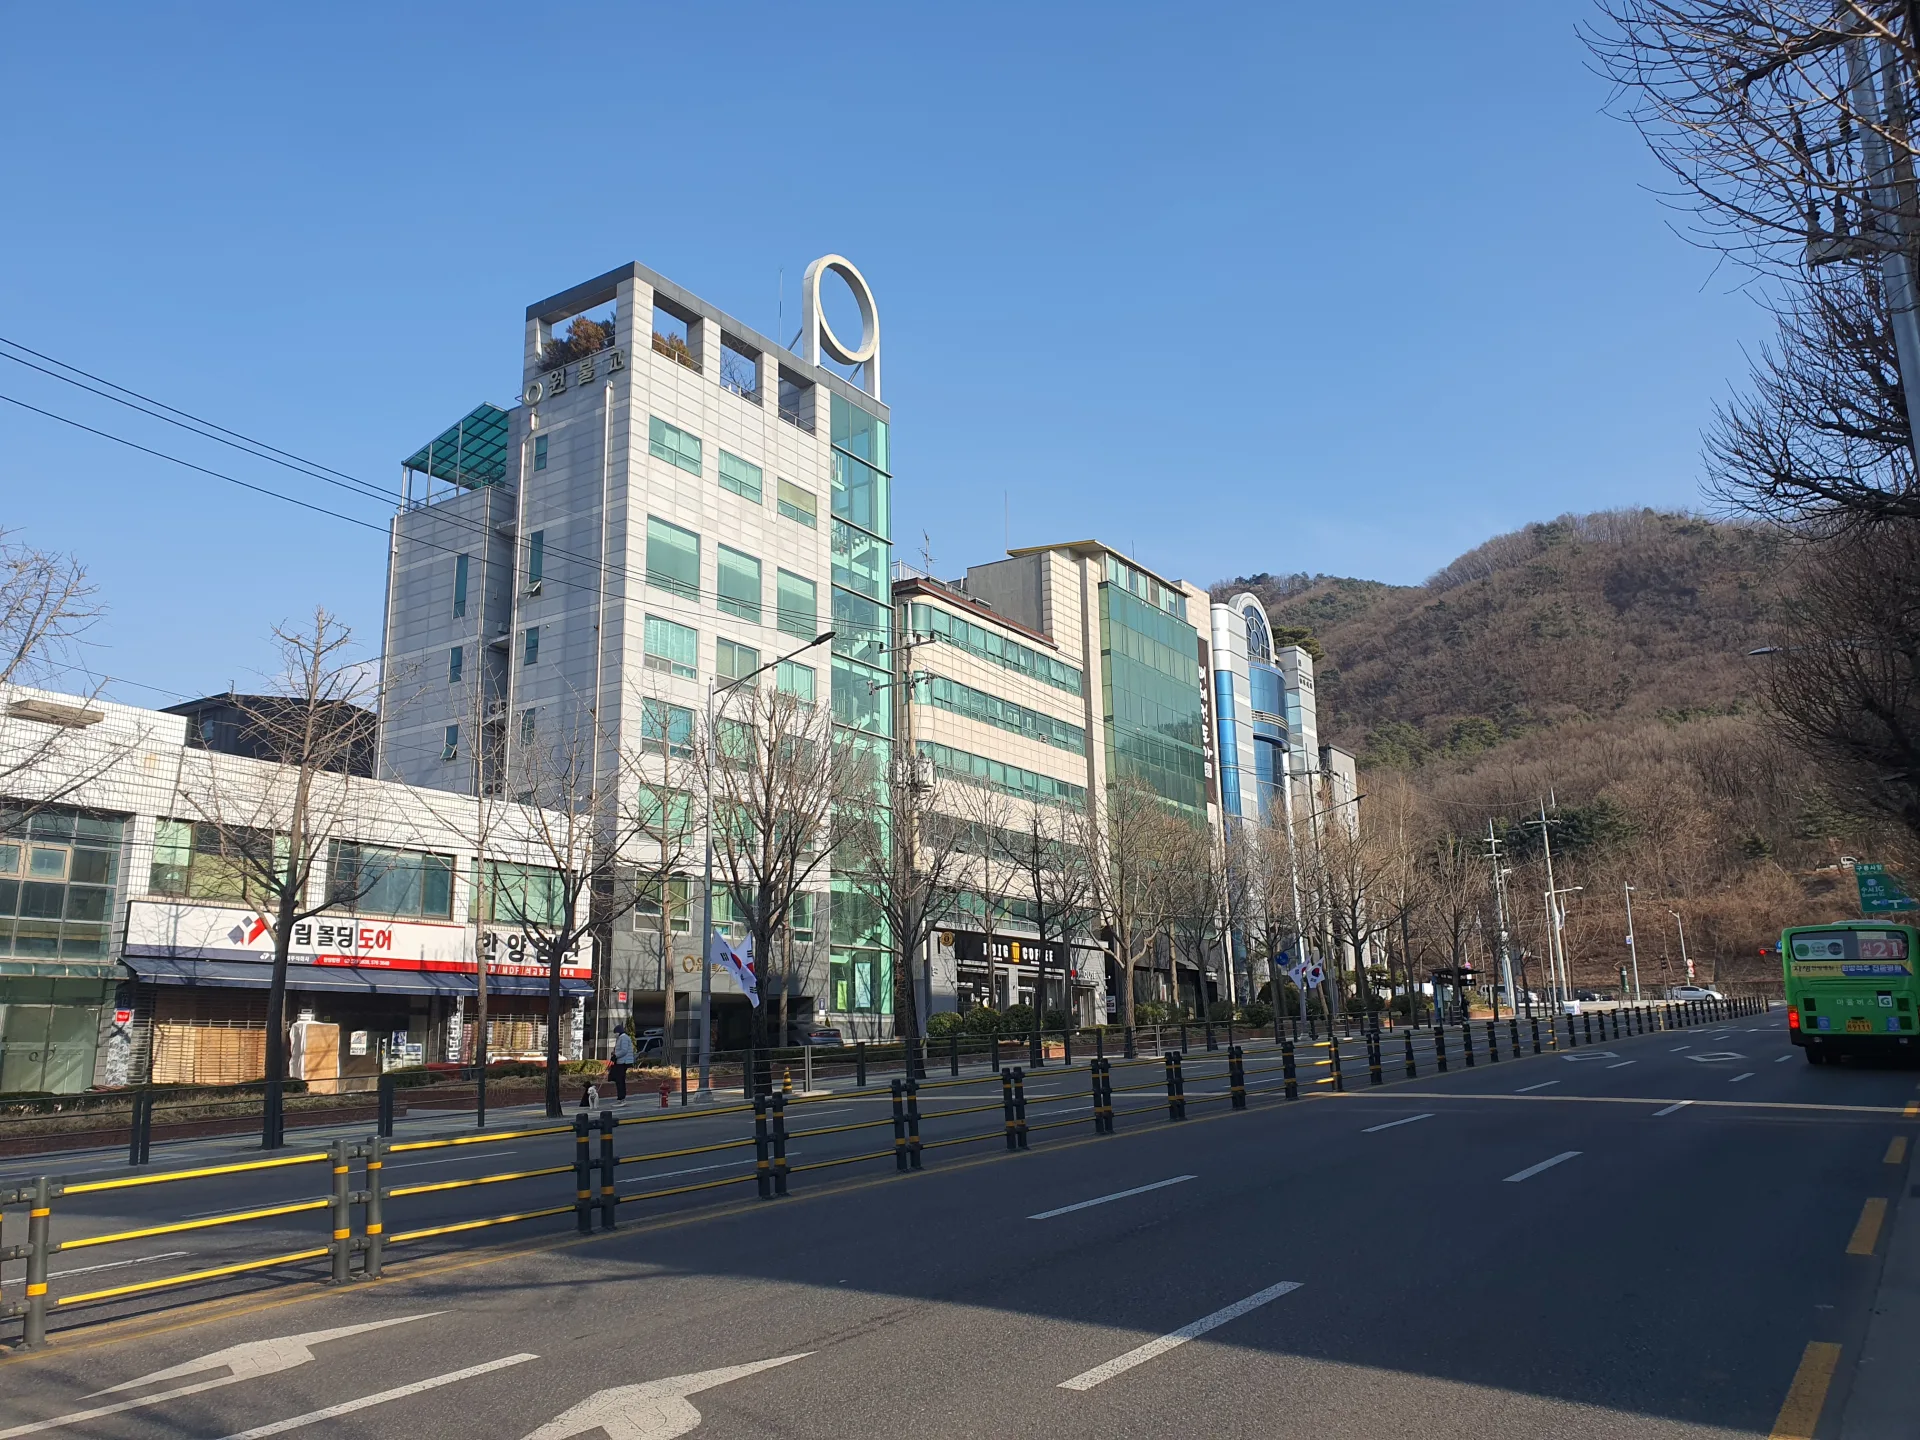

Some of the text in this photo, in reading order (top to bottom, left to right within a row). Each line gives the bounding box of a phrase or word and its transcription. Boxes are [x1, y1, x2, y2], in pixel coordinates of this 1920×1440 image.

[548, 350, 625, 398] 원불교
[317, 925, 353, 948] 몰딩
[358, 928, 391, 950] 도어
[1021, 946, 1054, 962] COFEE
[1873, 941, 1903, 957] 21
